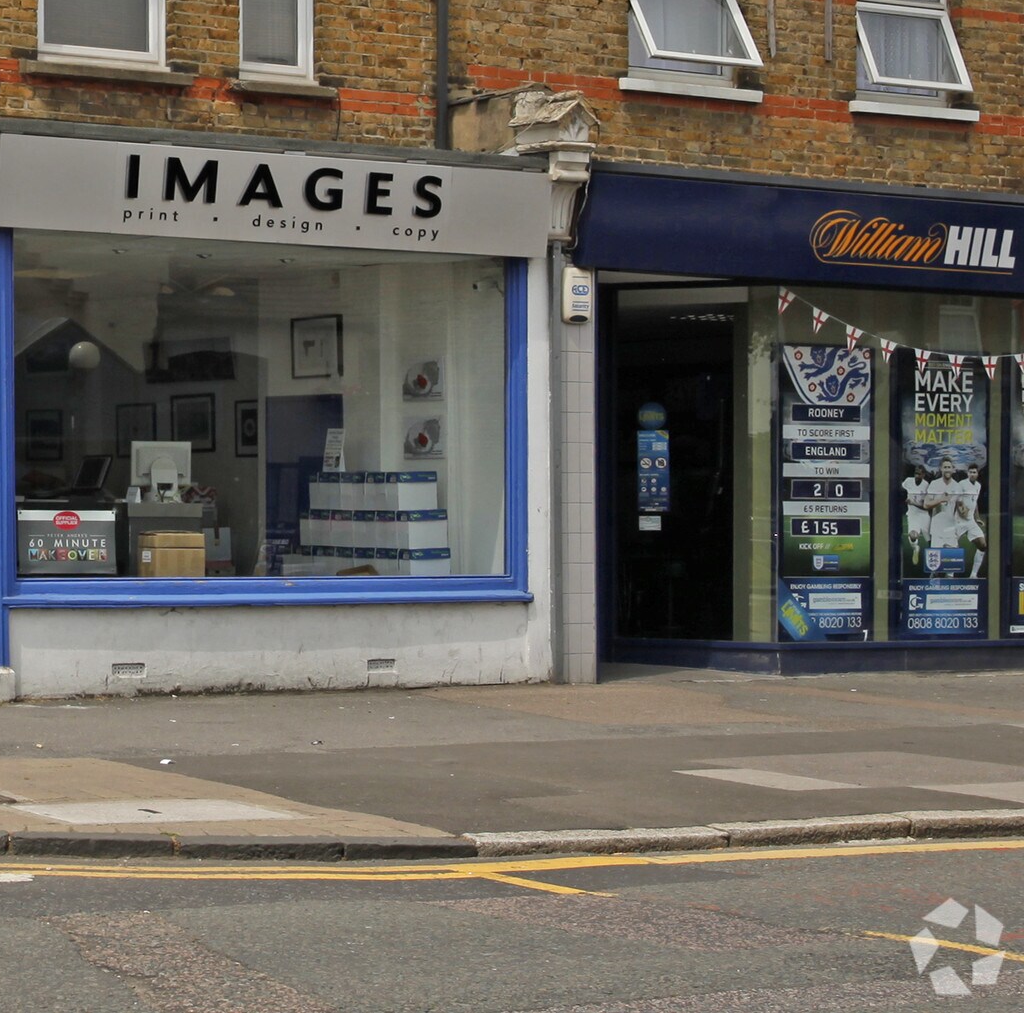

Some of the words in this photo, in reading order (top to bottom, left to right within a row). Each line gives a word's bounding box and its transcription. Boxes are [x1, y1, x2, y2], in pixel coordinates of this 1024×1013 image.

[124, 154, 444, 219] IMAGES
[123, 208, 180, 223] print
[252, 214, 324, 233] design
[392, 225, 440, 241] copy
[809, 209, 949, 264] William
[943, 225, 1016, 269] HILL
[914, 370, 974, 393] MAKE
[914, 393, 974, 412] EVERY
[808, 408, 845, 418] ROONEY
[914, 413, 973, 427] MOMENT
[798, 429, 808, 437] TO
[809, 429, 833, 437] SCORE
[834, 430, 855, 438] FIRST
[914, 428, 973, 444] MATTER
[805, 446, 847, 456] ENGLAND
[814, 467, 824, 475] TO
[826, 467, 840, 475] WIN
[813, 483, 822, 497] 2
[835, 484, 844, 497] 0
[803, 505, 814, 513] £5
[814, 505, 848, 514] RETURNS
[28, 538, 44, 548] 60
[54, 538, 106, 548] MINUTE
[28, 548, 108, 562] MAKEOVER
[818, 616, 844, 628] 8020
[846, 616, 862, 628] 133
[908, 617, 932, 629] 0808
[934, 617, 960, 629] 8020
[962, 617, 978, 628] 133
